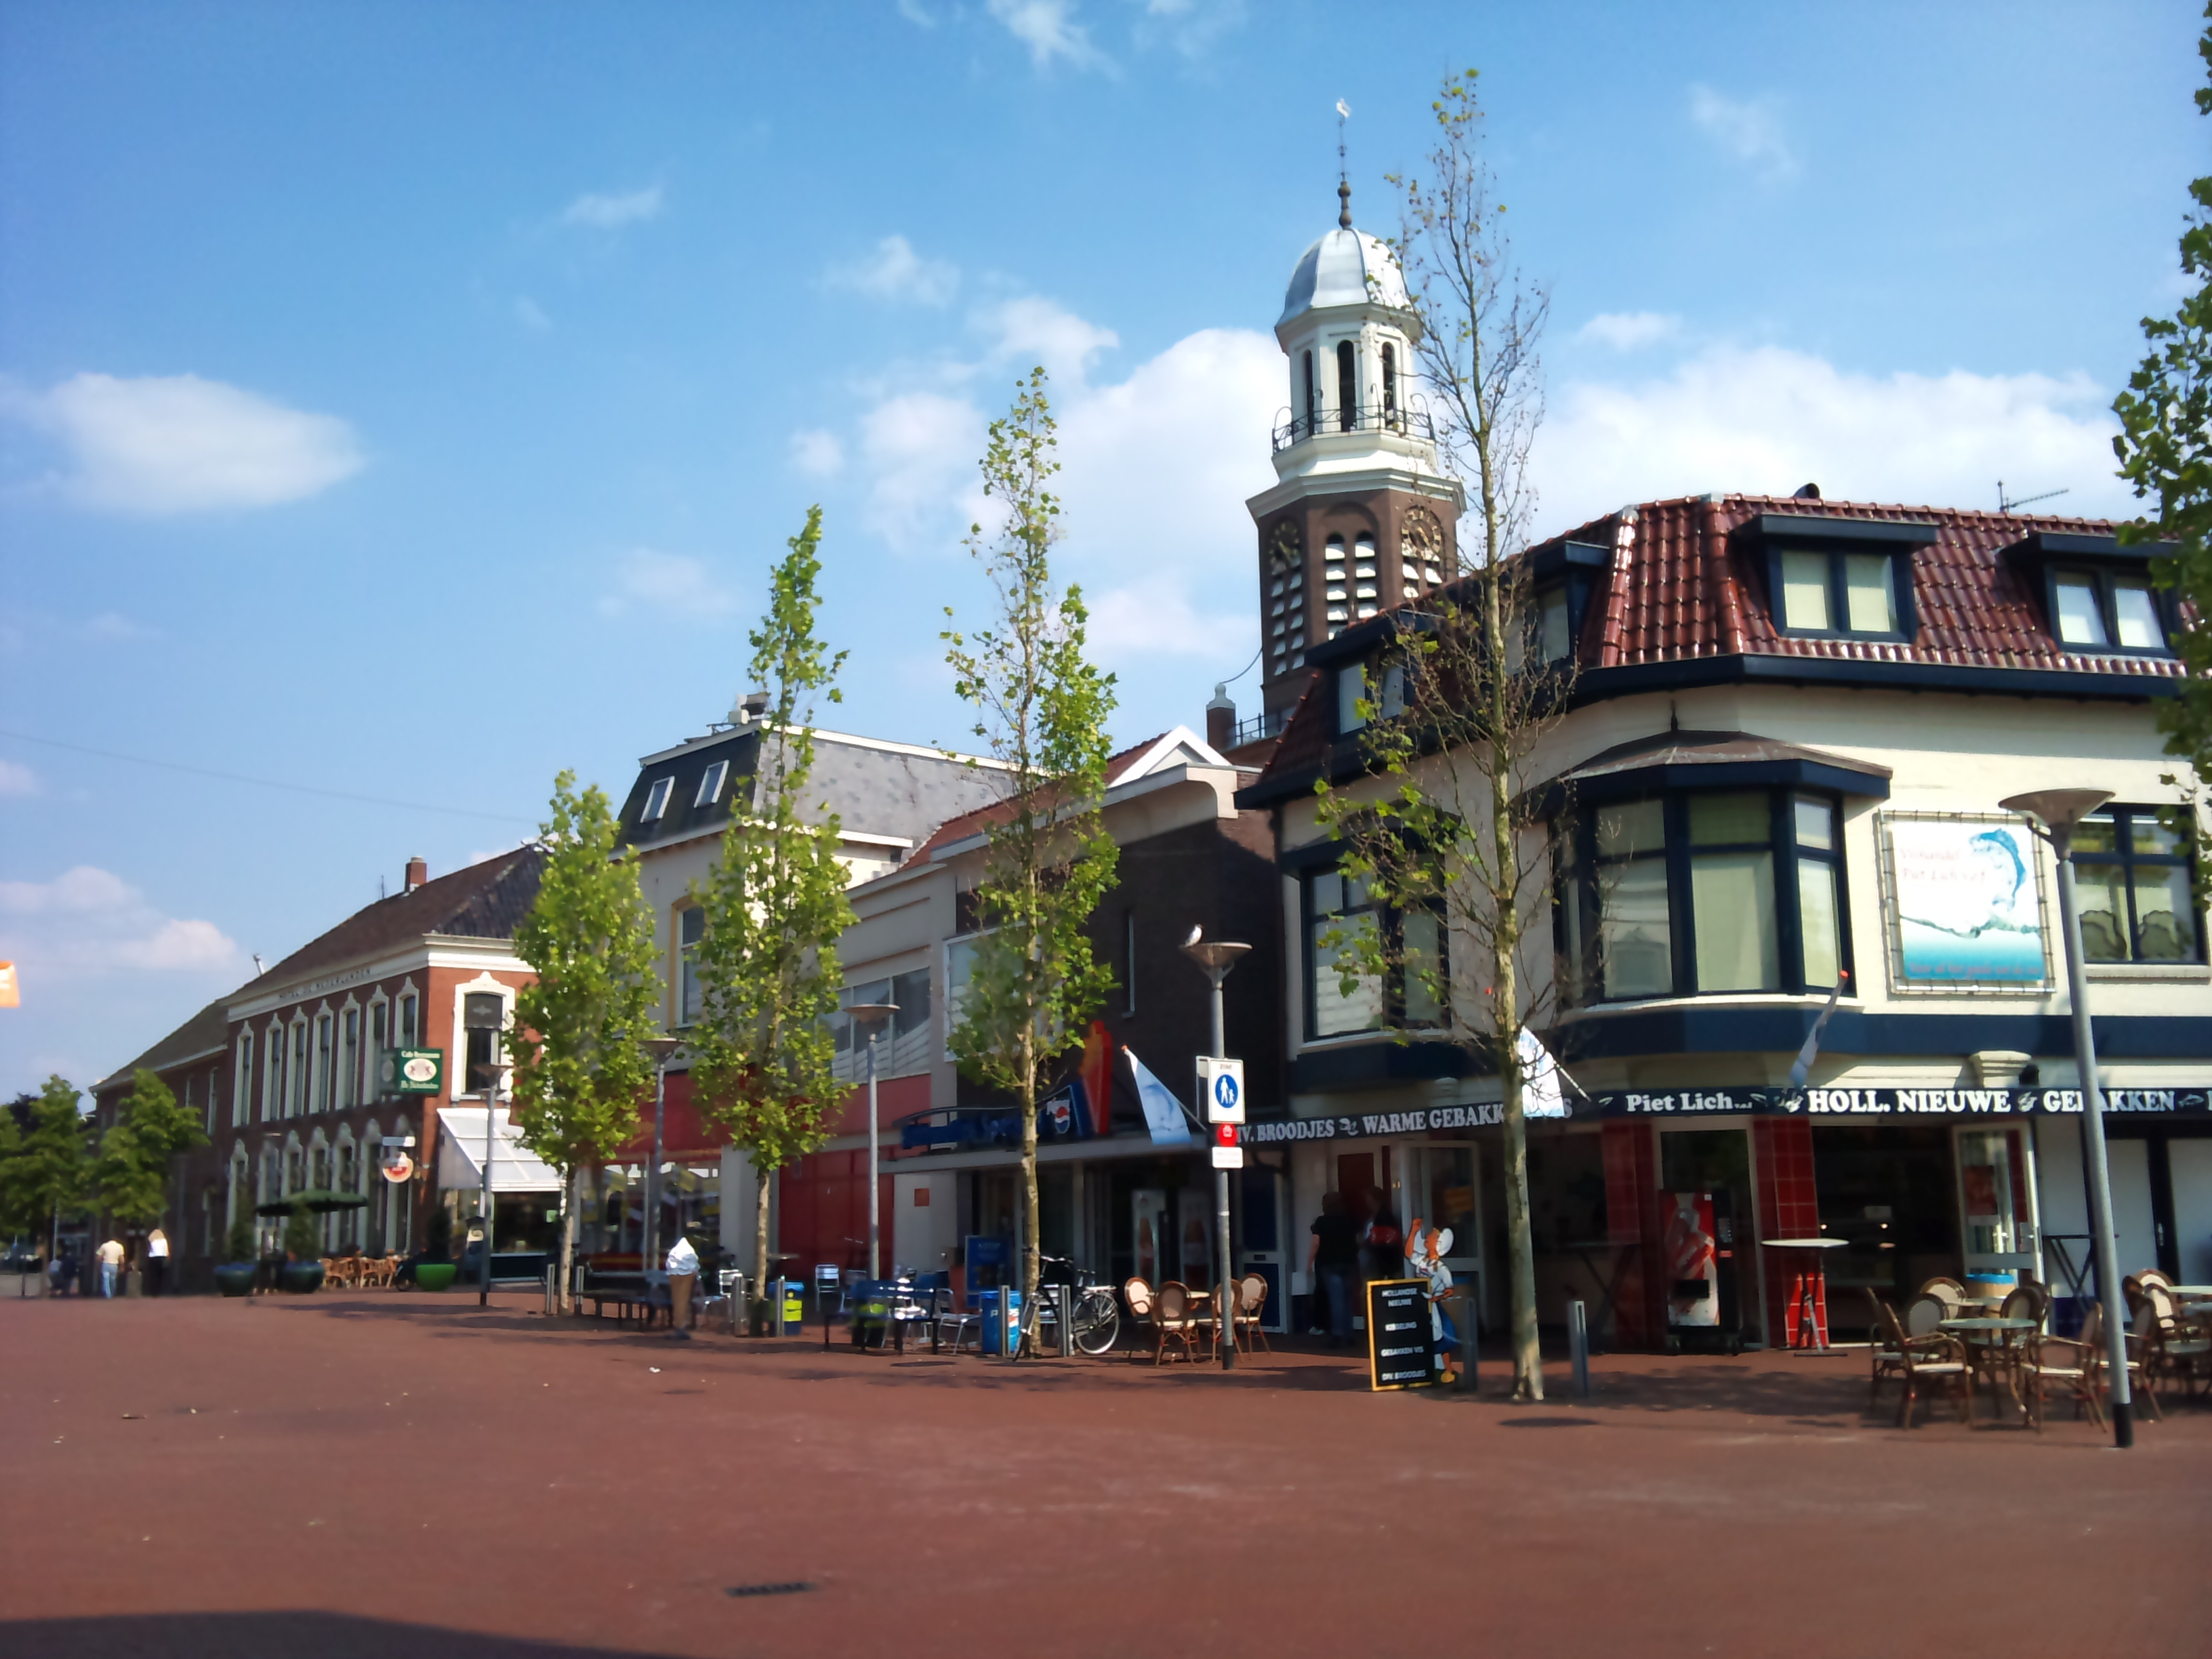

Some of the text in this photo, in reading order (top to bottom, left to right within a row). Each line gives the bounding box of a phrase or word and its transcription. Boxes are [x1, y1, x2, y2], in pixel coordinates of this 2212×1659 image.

[1625, 1094, 1675, 1112] Piet
[1679, 1092, 1734, 1111] Lich
[1807, 1090, 1891, 1113] HOLL.
[1896, 1090, 2011, 1113] NIEUWE
[1256, 1119, 1335, 1142] BROODJES
[1361, 1111, 1427, 1134] WARME
[1429, 1103, 1504, 1129] GEBAKK
[1381, 1288, 1418, 1298] HOLLANDSE
[1387, 1298, 1412, 1307] NIEUWE
[1380, 1347, 1413, 1357] GEBAKKEN
